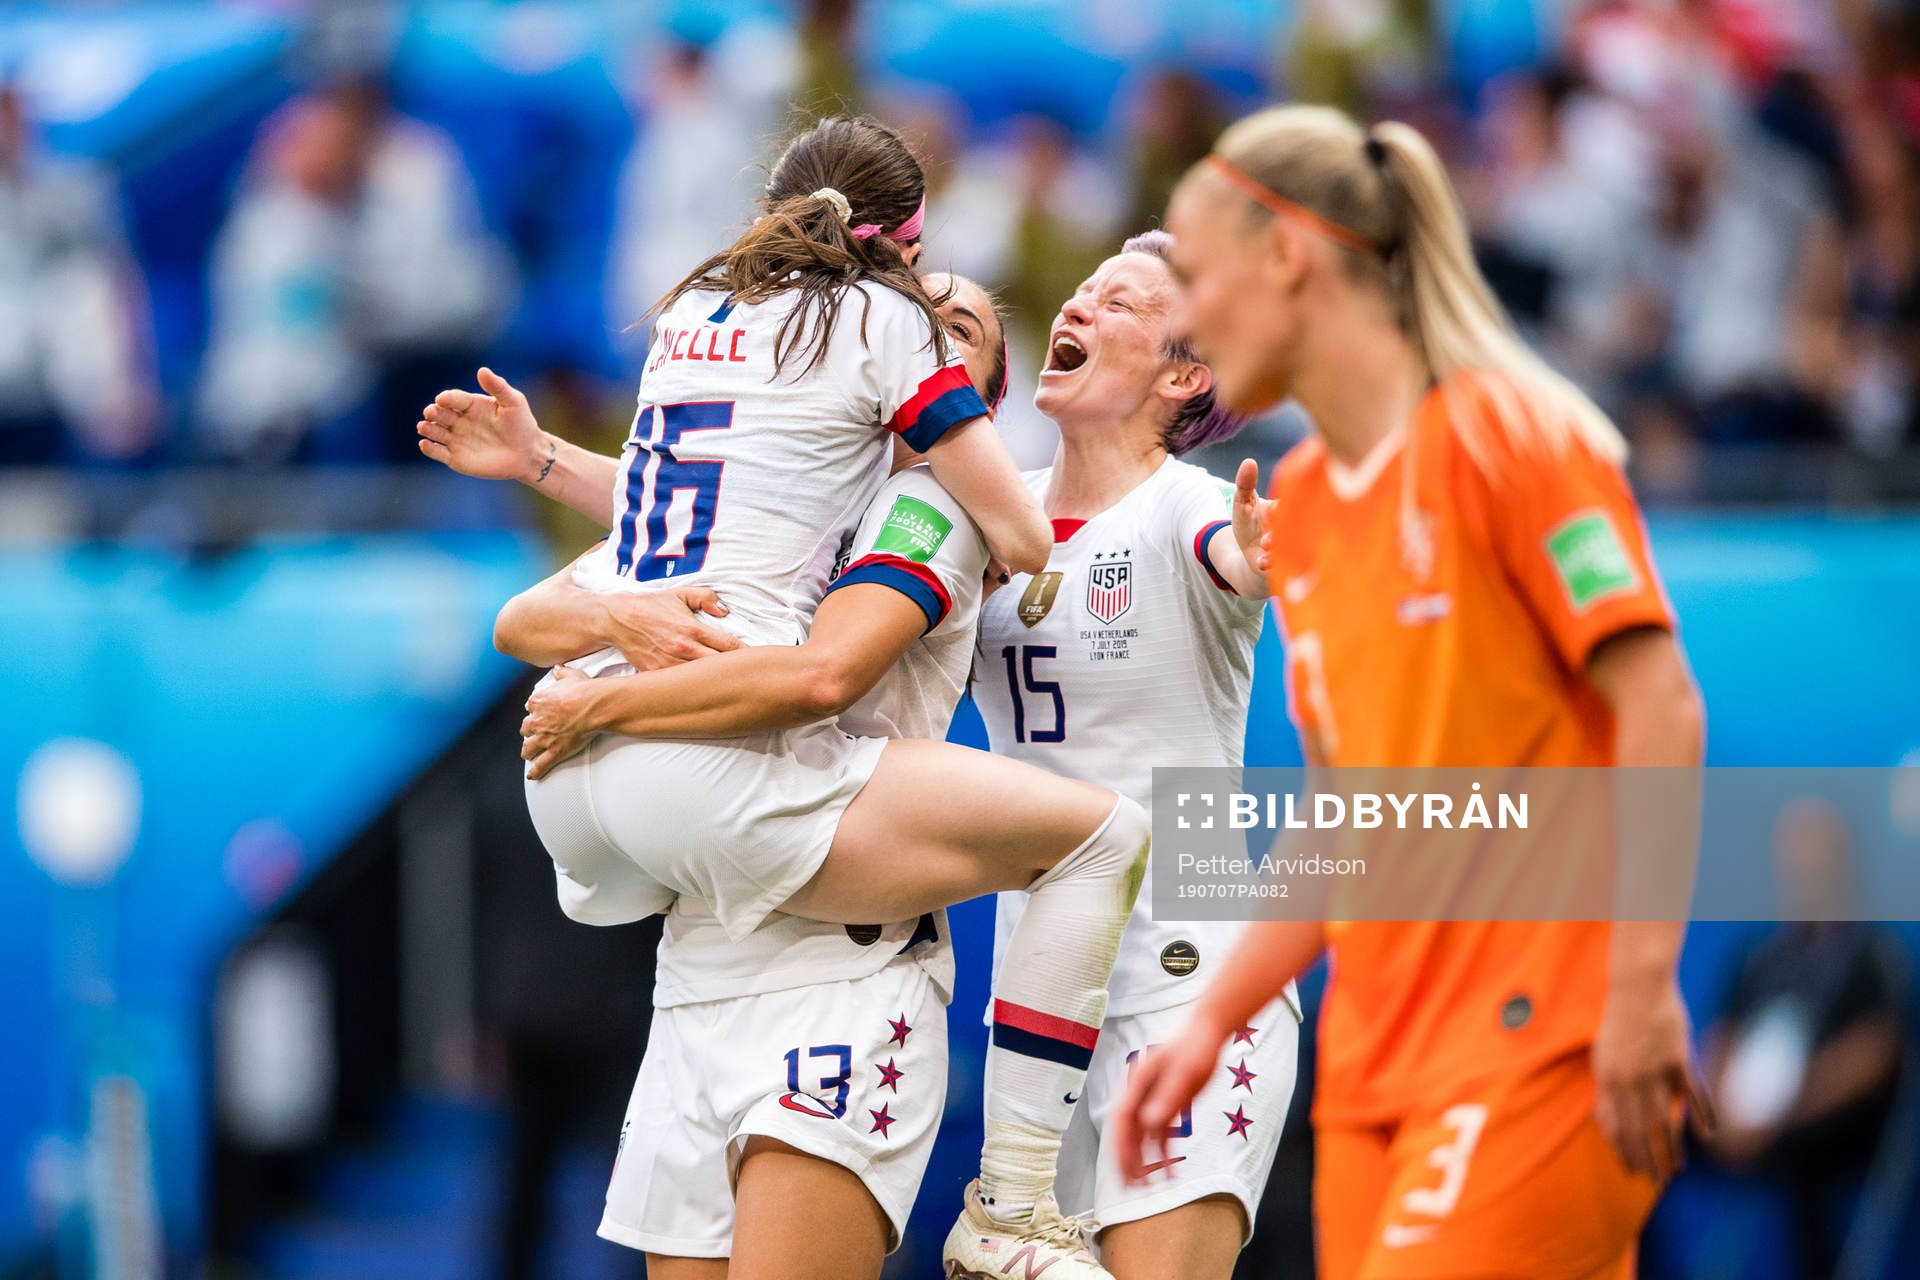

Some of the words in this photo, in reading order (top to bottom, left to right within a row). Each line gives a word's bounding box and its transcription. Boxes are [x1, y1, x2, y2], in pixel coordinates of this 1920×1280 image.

[616, 401, 735, 583] 16
[889, 516, 937, 545] FOOTBALL
[893, 510, 942, 539] LIVING
[909, 535, 933, 555] FIFA
[1093, 567, 1127, 589] USA
[1025, 604, 1045, 613] FIFA
[1080, 630, 1091, 639] USA
[1098, 628, 1139, 639] NETHERLANDS
[1097, 640, 1110, 650] JULY
[1112, 639, 1128, 649] 2019
[1090, 651, 1104, 661] LYON
[1106, 650, 1130, 660] FRANCE
[1002, 645, 1066, 744] 15
[783, 1044, 852, 1119] 13
[1402, 1103, 1488, 1218] 3
